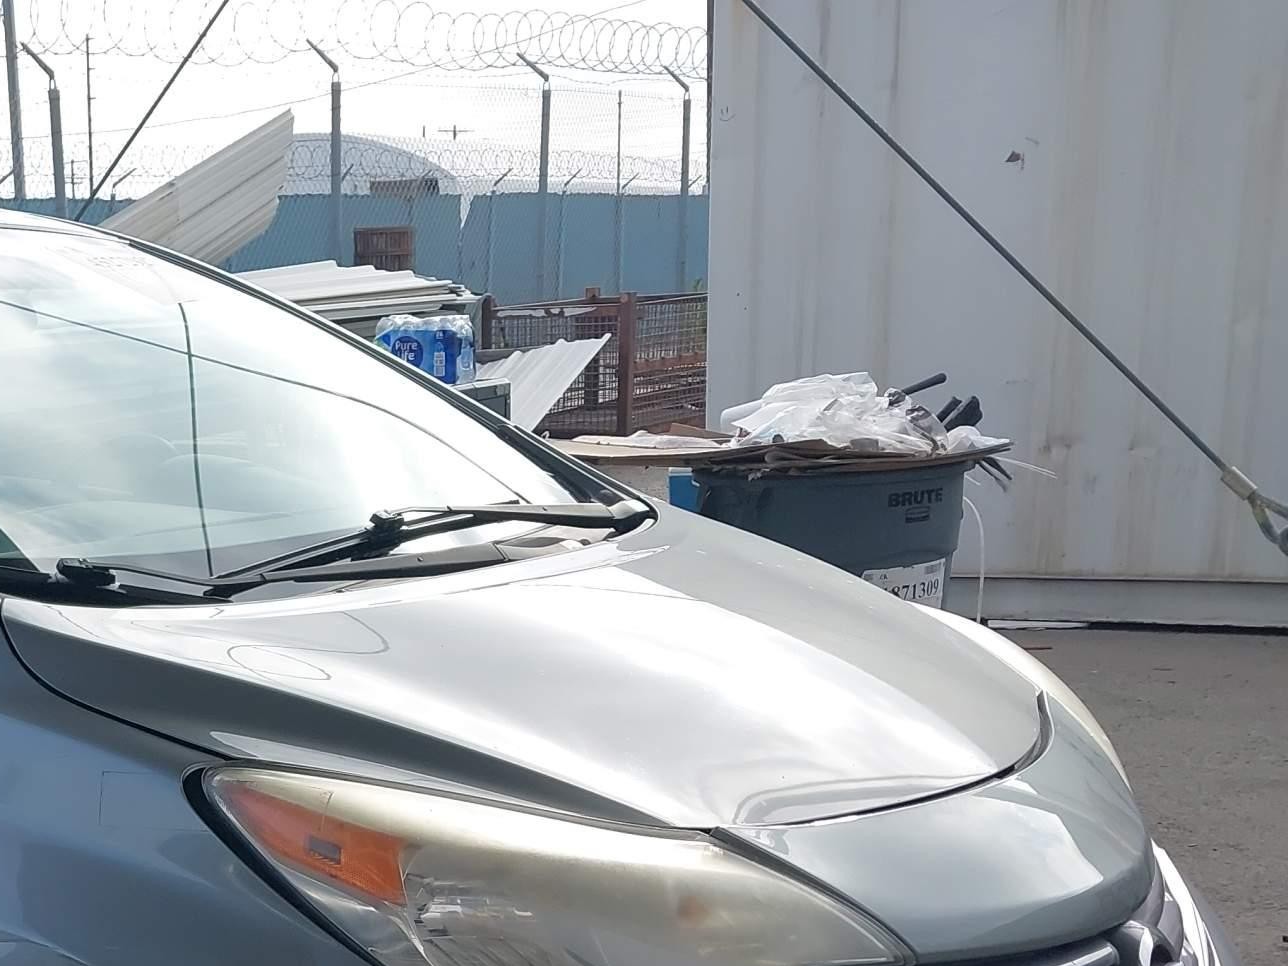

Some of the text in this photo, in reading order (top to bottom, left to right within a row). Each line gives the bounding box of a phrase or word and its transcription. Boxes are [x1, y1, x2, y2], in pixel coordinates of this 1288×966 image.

[395, 340, 418, 351] Pure
[887, 488, 943, 507] BRUTE
[884, 578, 939, 600] 871309
